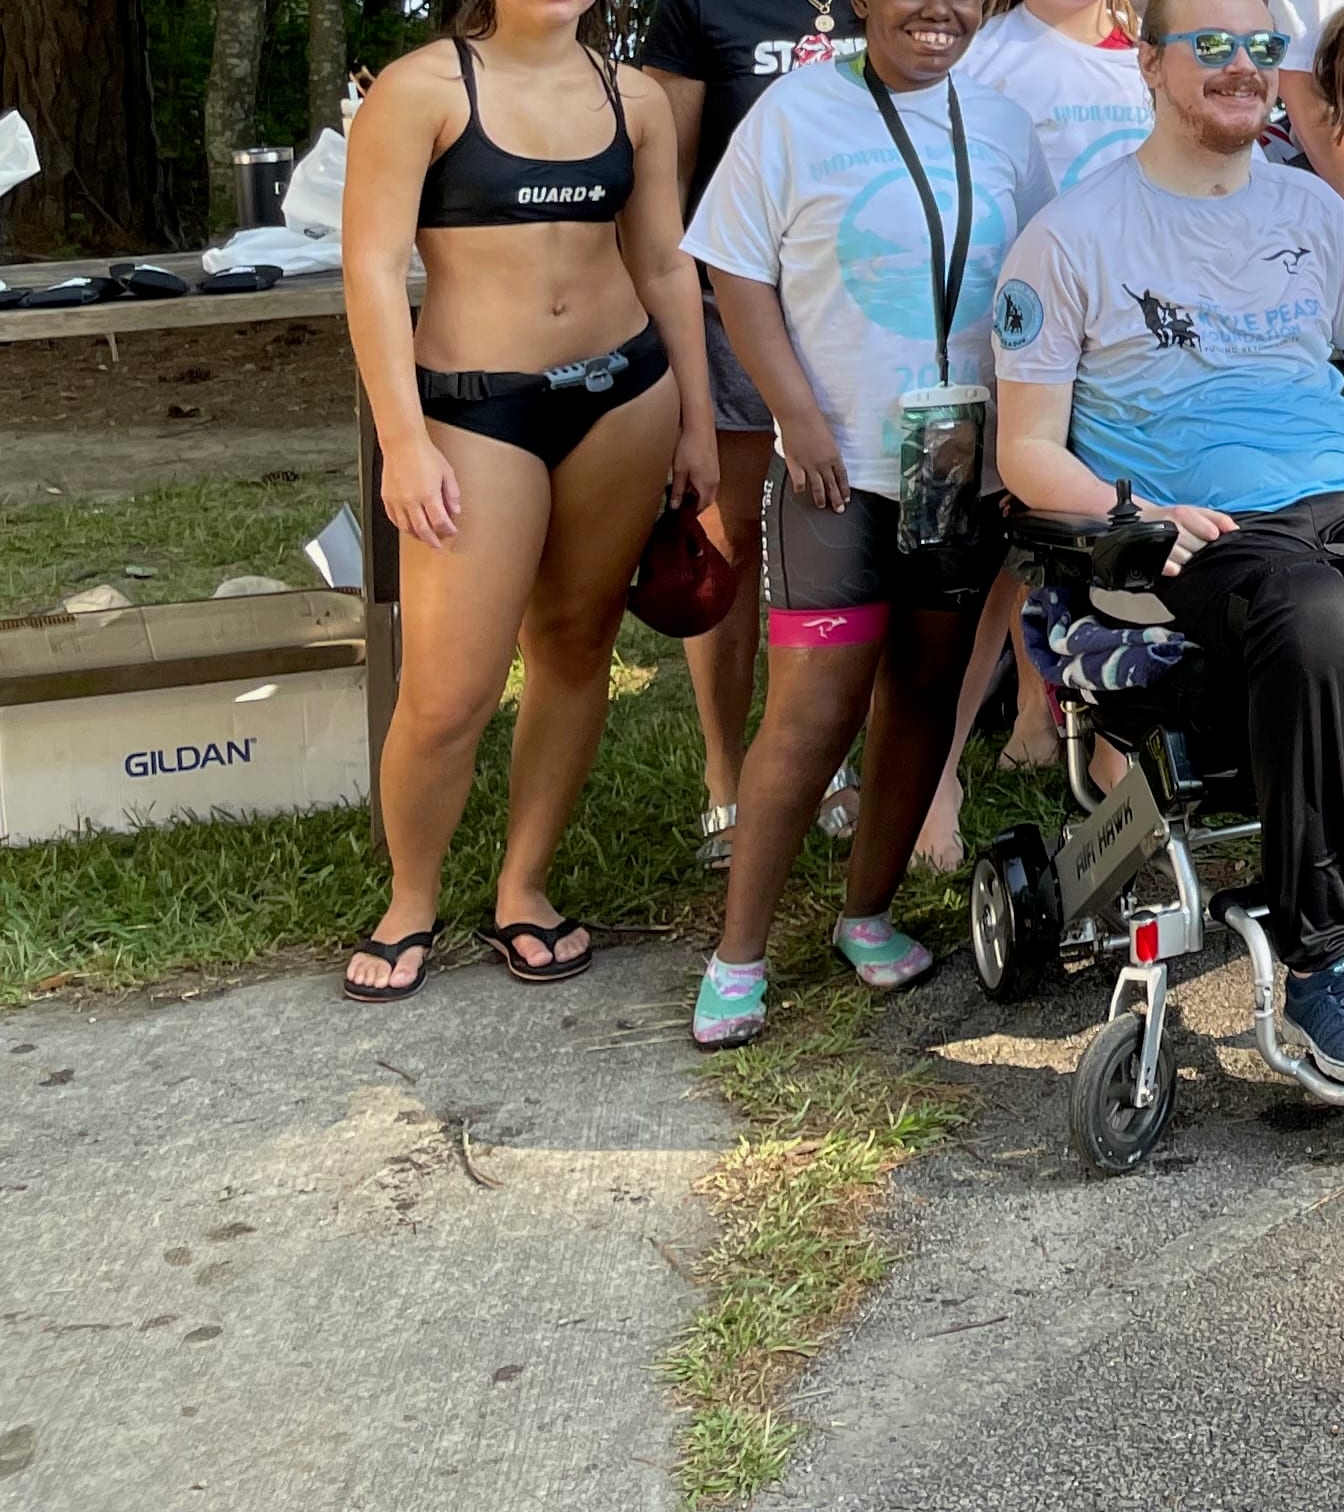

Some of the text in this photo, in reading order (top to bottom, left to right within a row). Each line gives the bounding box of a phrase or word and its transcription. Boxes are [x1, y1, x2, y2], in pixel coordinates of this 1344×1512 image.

[517, 185, 588, 204] GUARD
[124, 737, 252, 778] GILDAN
[1097, 795, 1134, 856] HAWK
